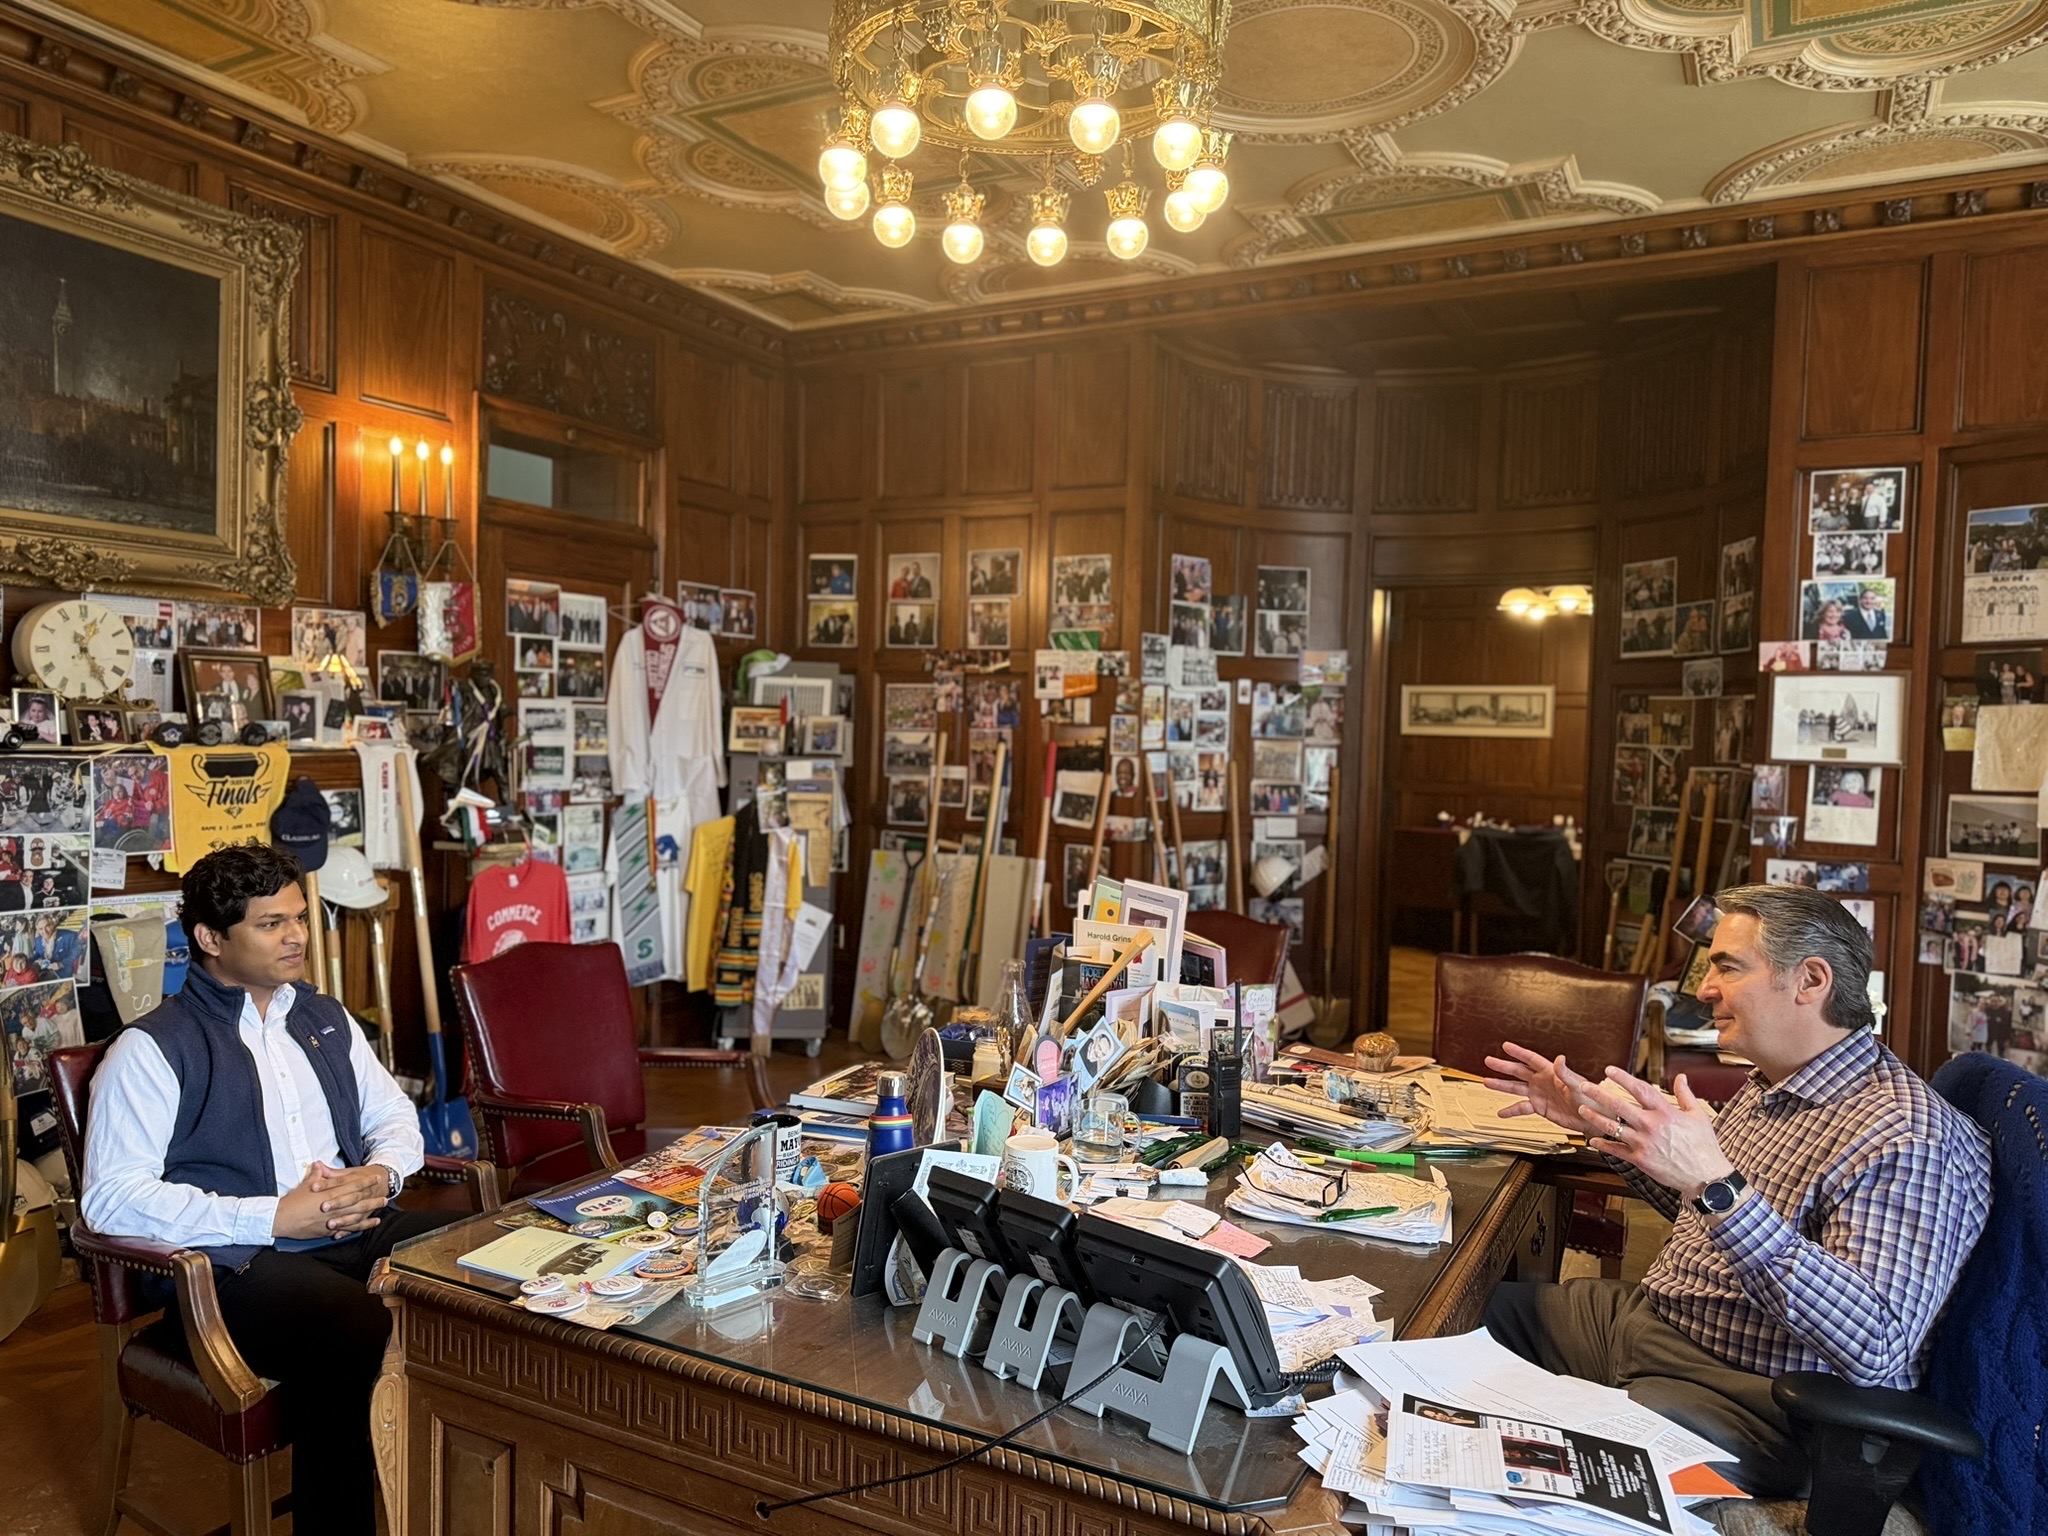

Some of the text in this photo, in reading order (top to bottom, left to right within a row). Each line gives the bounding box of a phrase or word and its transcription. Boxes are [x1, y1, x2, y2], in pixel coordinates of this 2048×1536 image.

[205, 778, 262, 808] Finals
[487, 904, 542, 931] COMMERCE
[1087, 931, 1111, 941] Harold
[776, 1159, 796, 1169] RIDING
[580, 1197, 623, 1212] SPFLD
[928, 1308, 958, 1328] AVAYA
[1000, 1337, 1032, 1359] AVAYA
[1112, 1382, 1149, 1406] AVAYA
